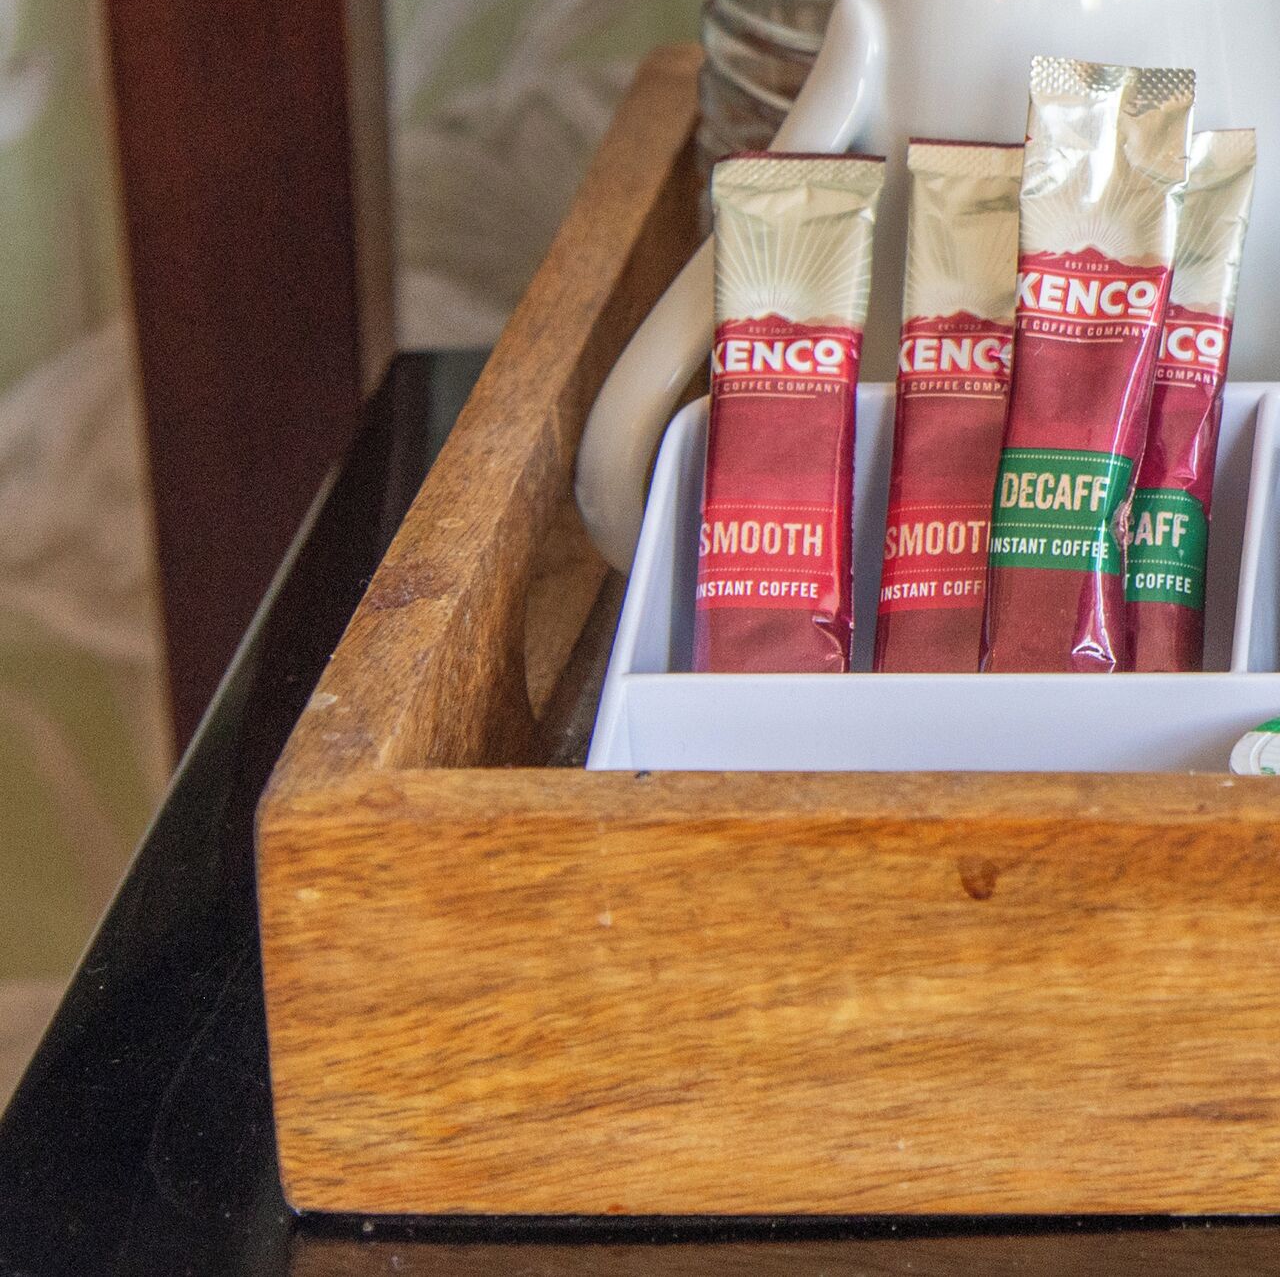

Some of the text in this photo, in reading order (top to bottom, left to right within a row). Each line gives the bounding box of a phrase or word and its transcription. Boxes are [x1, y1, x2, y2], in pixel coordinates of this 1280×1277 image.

[1065, 260, 1082, 270] EST
[1016, 272, 1157, 316] KENCO
[1033, 319, 1082, 335] COFFEE
[1087, 324, 1148, 338] COMPANY
[1159, 325, 1224, 364] CO
[723, 380, 771, 392] COFFEE
[777, 381, 841, 394] COMPANY
[911, 381, 959, 391] COFFEE
[1000, 472, 1110, 512] DECAFF
[699, 521, 823, 557] SMOOTH
[884, 521, 991, 560] SMOOT
[990, 537, 1109, 559] INSTANT COFFEE
[696, 580, 819, 600] INSTANT COFFEE
[880, 580, 986, 603] INSTANT COFF
[1135, 573, 1192, 593] COFFEE
